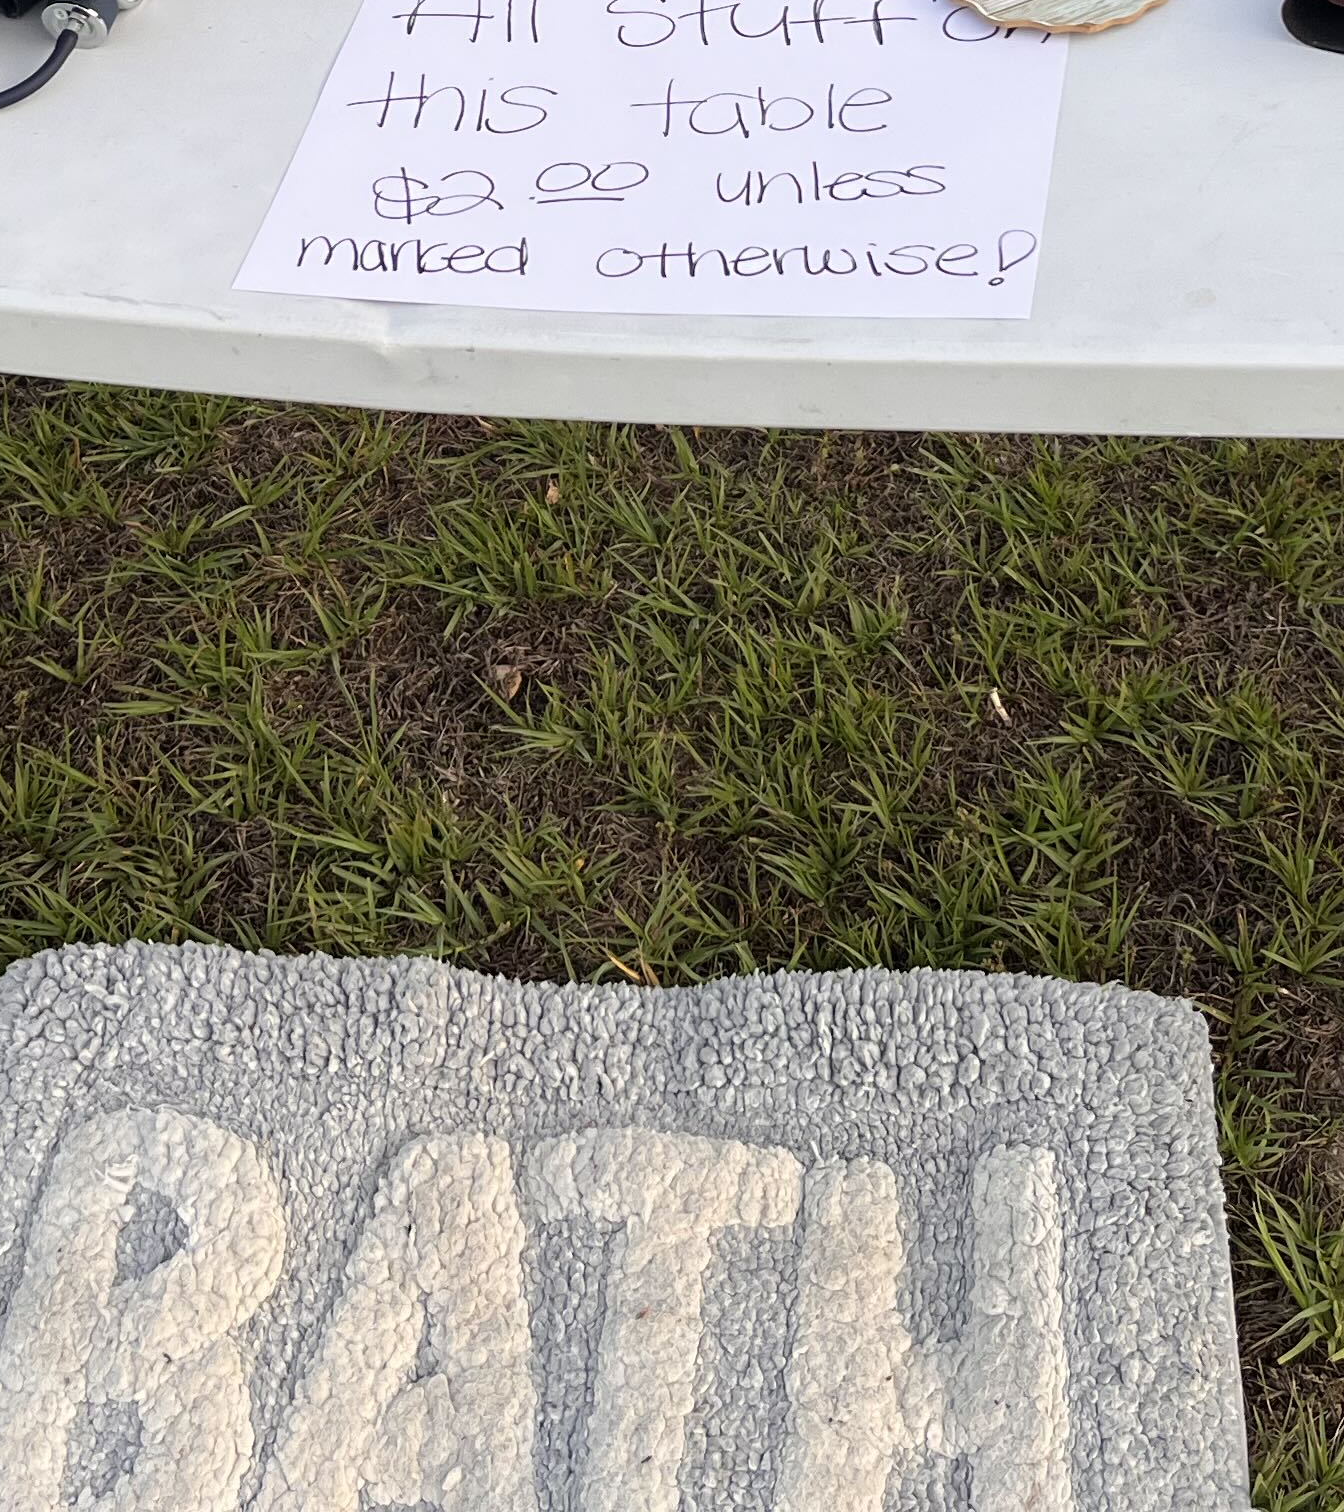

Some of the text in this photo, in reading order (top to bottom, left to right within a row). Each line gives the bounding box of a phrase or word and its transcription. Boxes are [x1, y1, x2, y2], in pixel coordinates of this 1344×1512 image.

[942, 5, 1053, 44] o
[348, 71, 894, 139] this table
[716, 162, 946, 206] unless
[297, 228, 1036, 286] marked otherwise!
